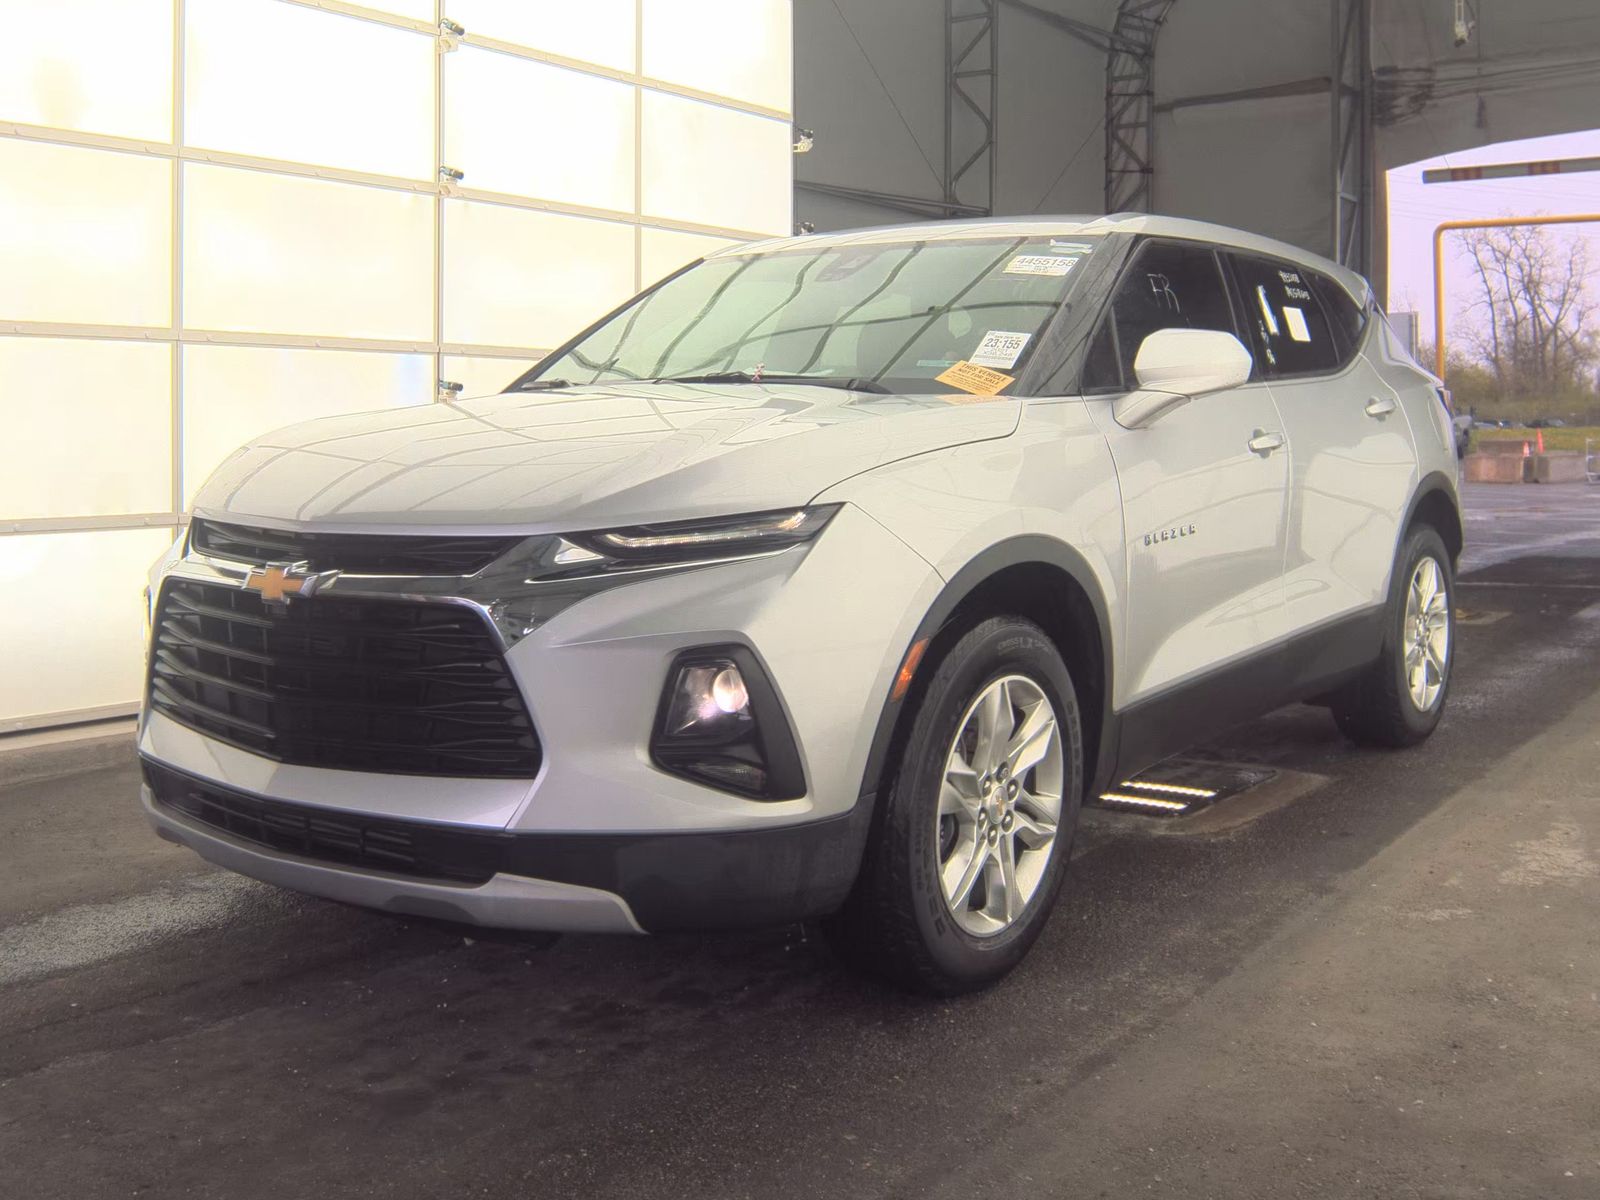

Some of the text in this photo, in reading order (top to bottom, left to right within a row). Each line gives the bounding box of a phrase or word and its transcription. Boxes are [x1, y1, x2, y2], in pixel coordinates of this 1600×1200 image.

[958, 367, 973, 376] NOT
[972, 371, 985, 380] FOR
[983, 376, 1000, 385] SALE
[961, 363, 979, 372] THIS
[978, 367, 1008, 382] VEHICLE
[1143, 524, 1197, 547] BLAZER
